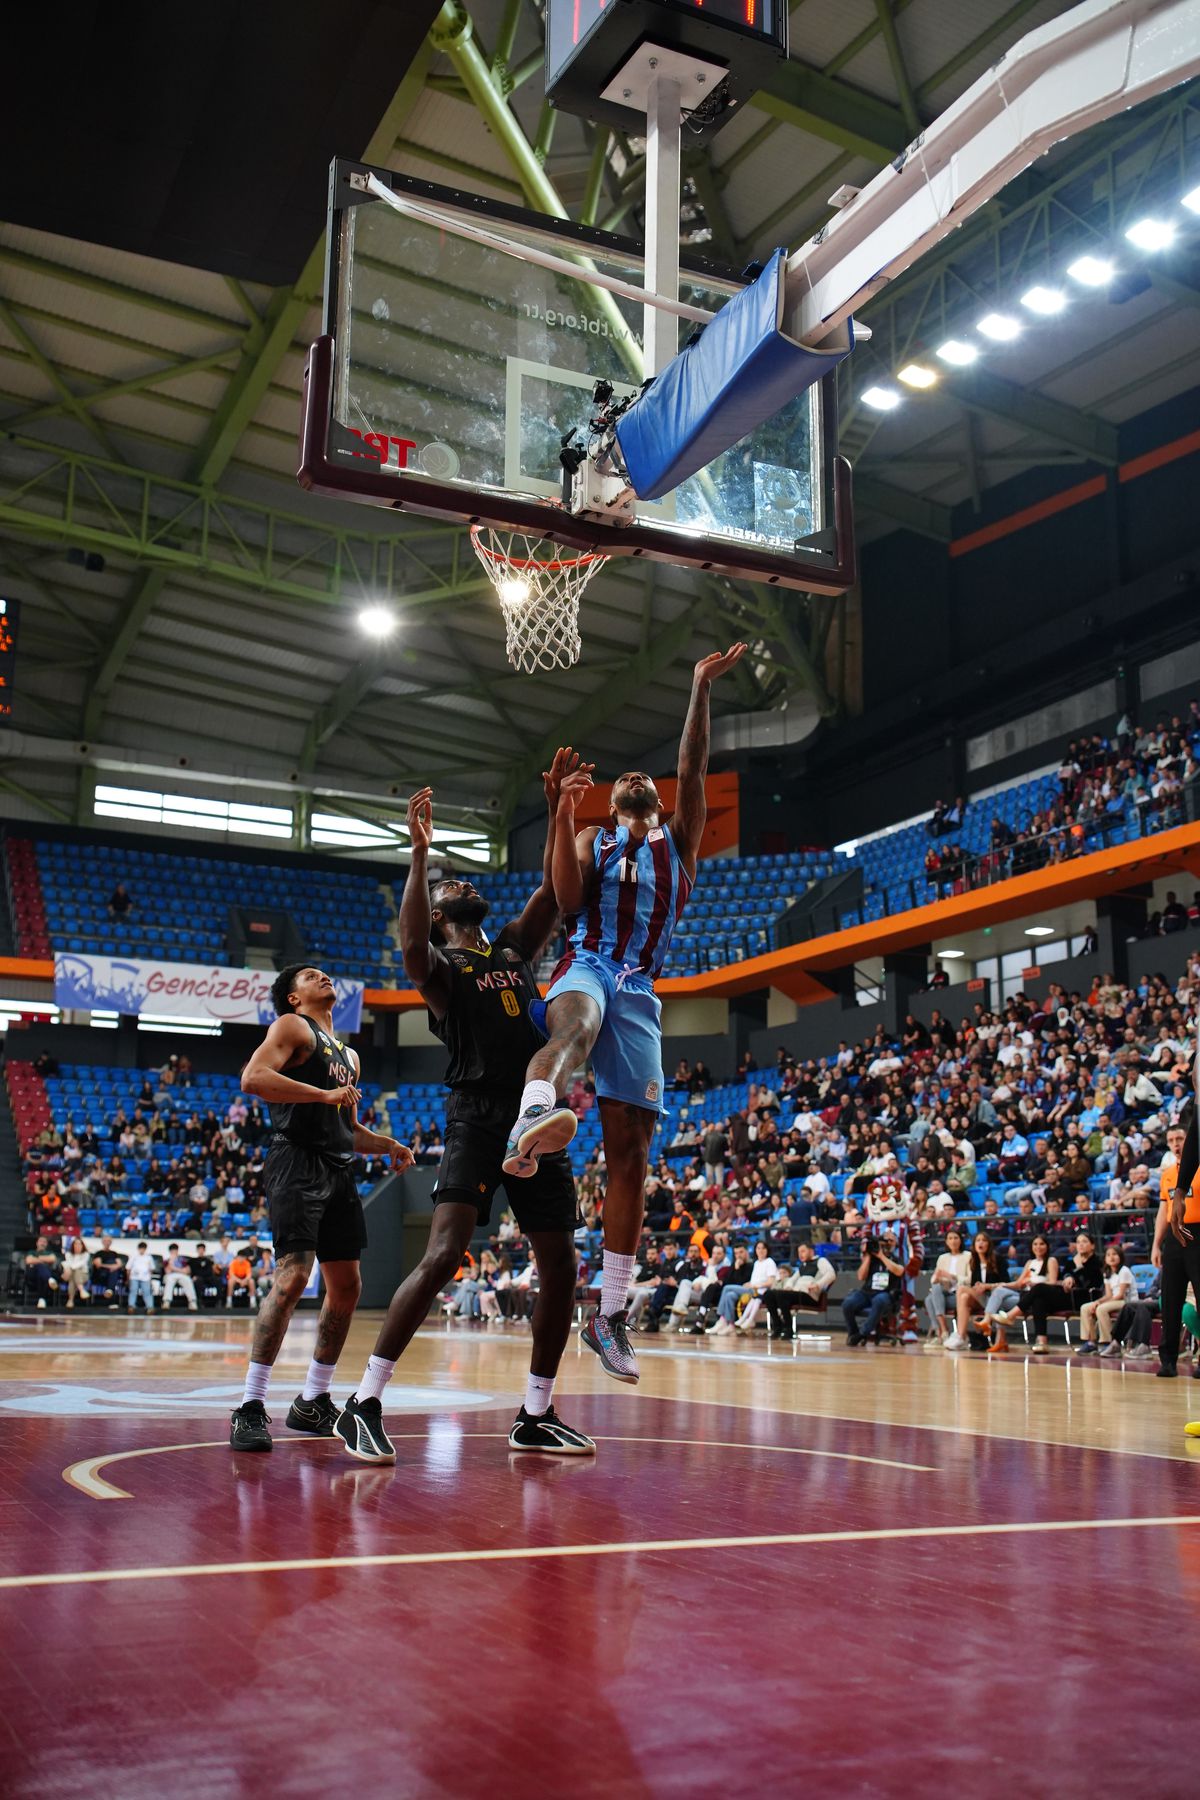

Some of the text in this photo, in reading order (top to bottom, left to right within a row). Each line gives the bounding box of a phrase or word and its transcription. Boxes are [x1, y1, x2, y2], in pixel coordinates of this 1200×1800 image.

[617, 856, 639, 883] 17
[475, 970, 525, 992] MSK
[500, 989, 521, 1017] 0
[328, 1061, 354, 1087] MSK
